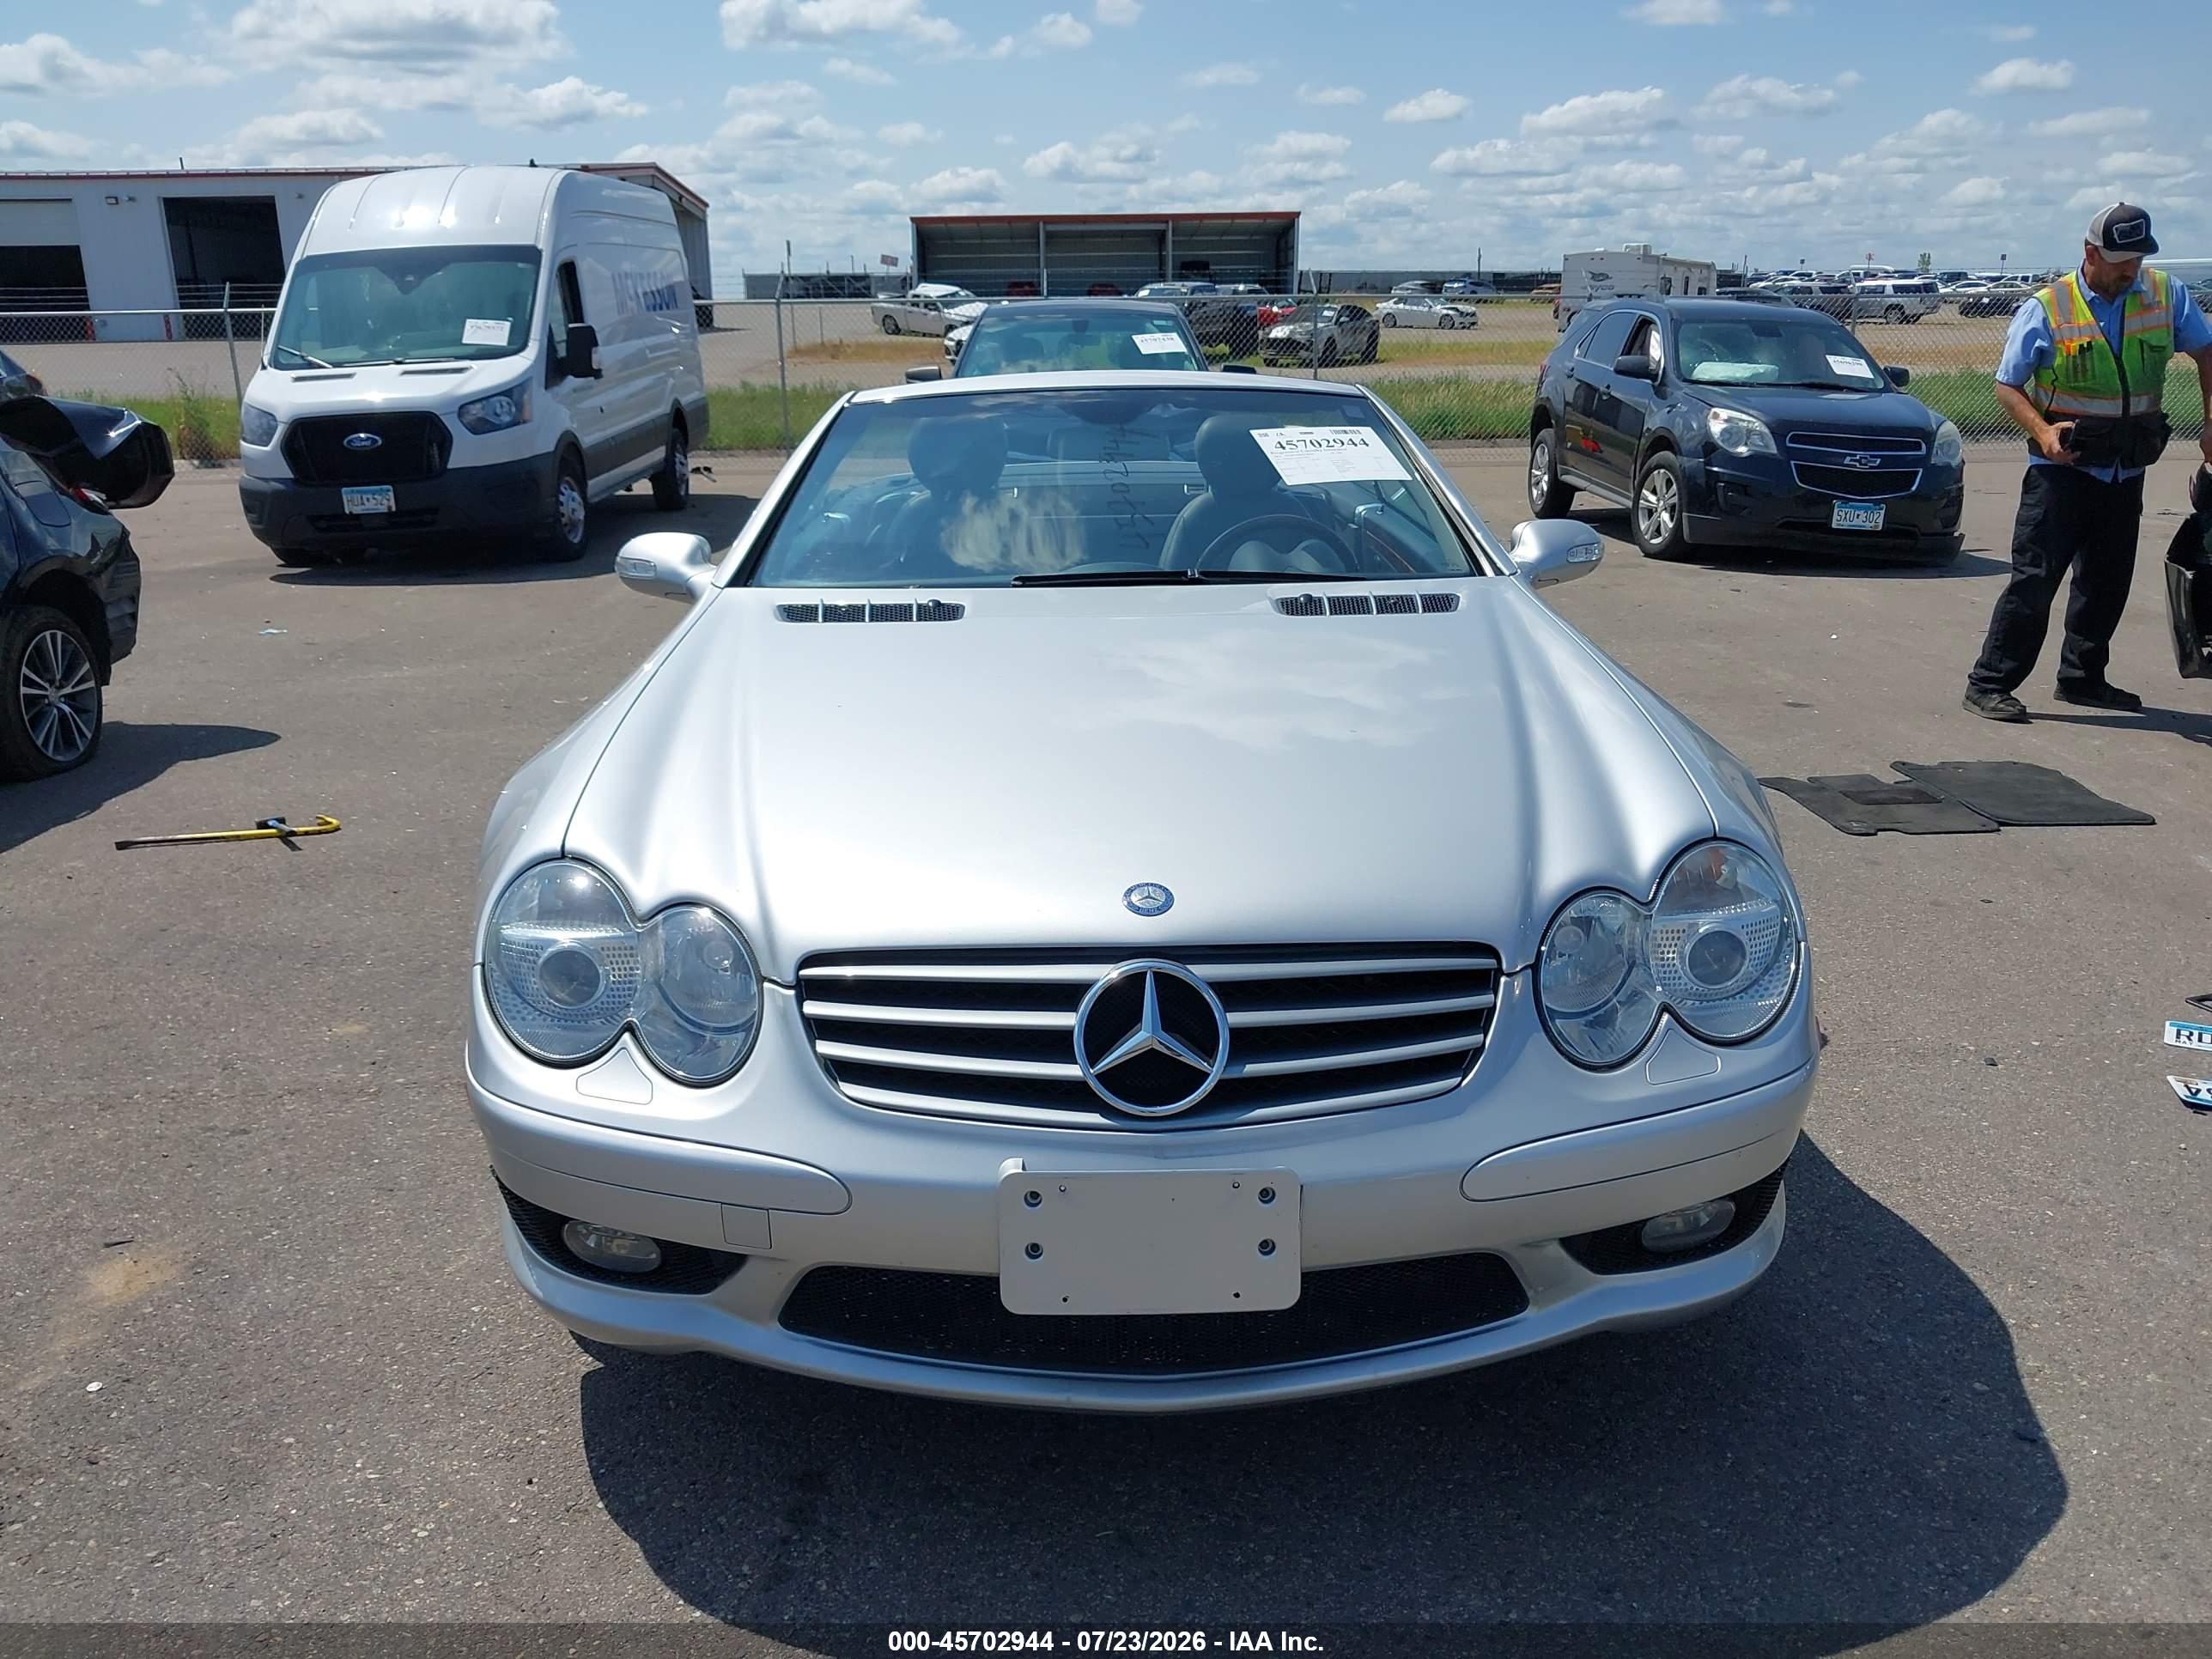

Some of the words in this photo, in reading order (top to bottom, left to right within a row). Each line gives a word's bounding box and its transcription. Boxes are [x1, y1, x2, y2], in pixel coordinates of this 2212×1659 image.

[1274, 437, 1370, 451] 45702944
[1835, 509, 1856, 523] SXU
[1861, 510, 1881, 524] 302
